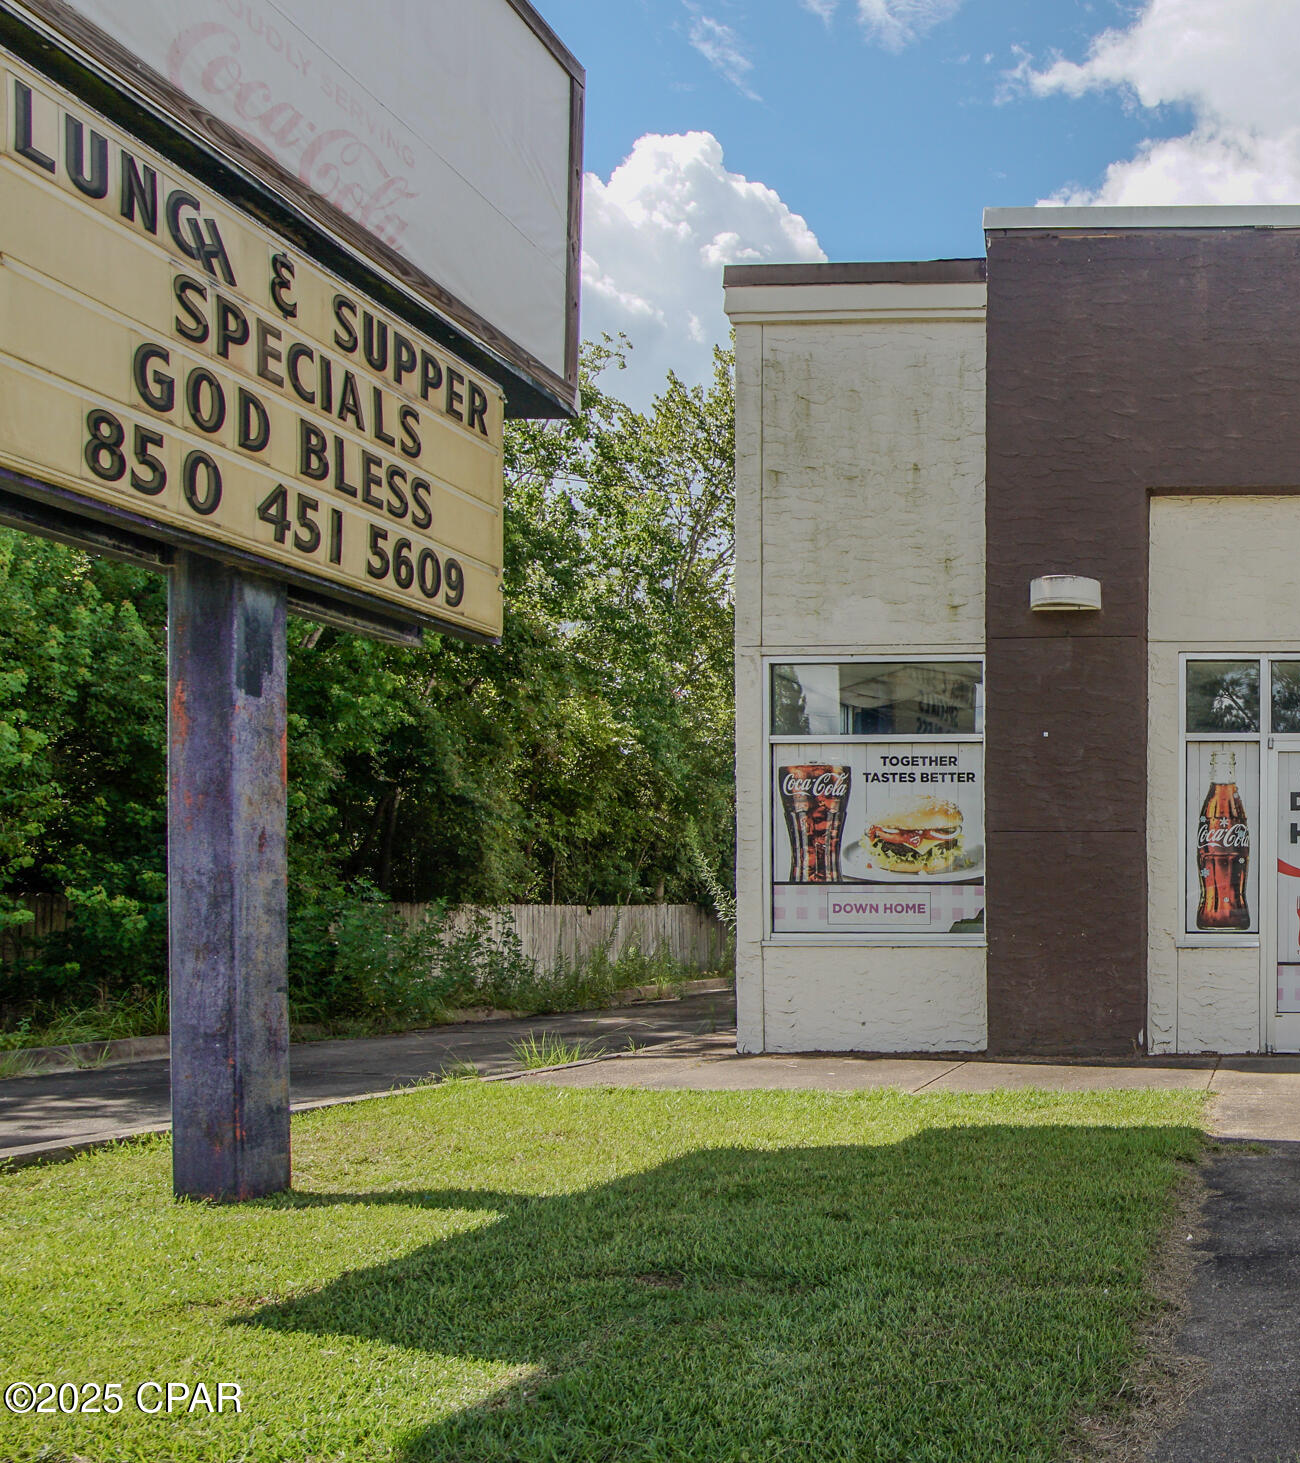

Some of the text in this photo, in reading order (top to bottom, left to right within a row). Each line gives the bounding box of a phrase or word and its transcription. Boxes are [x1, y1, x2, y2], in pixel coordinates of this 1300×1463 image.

[225, 0, 416, 168] OUDLY SERVING
[14, 79, 488, 437] LUNCH & SUPPER
[134, 343, 432, 530] GOD BLESS
[174, 274, 422, 458] SPECIALS
[85, 409, 464, 607] 850 451 5609
[783, 772, 848, 797] Coca-Cola
[863, 772, 976, 783] TASTES BETTER
[880, 756, 957, 766] TOGETHER
[832, 903, 926, 914] DOWN HOME
